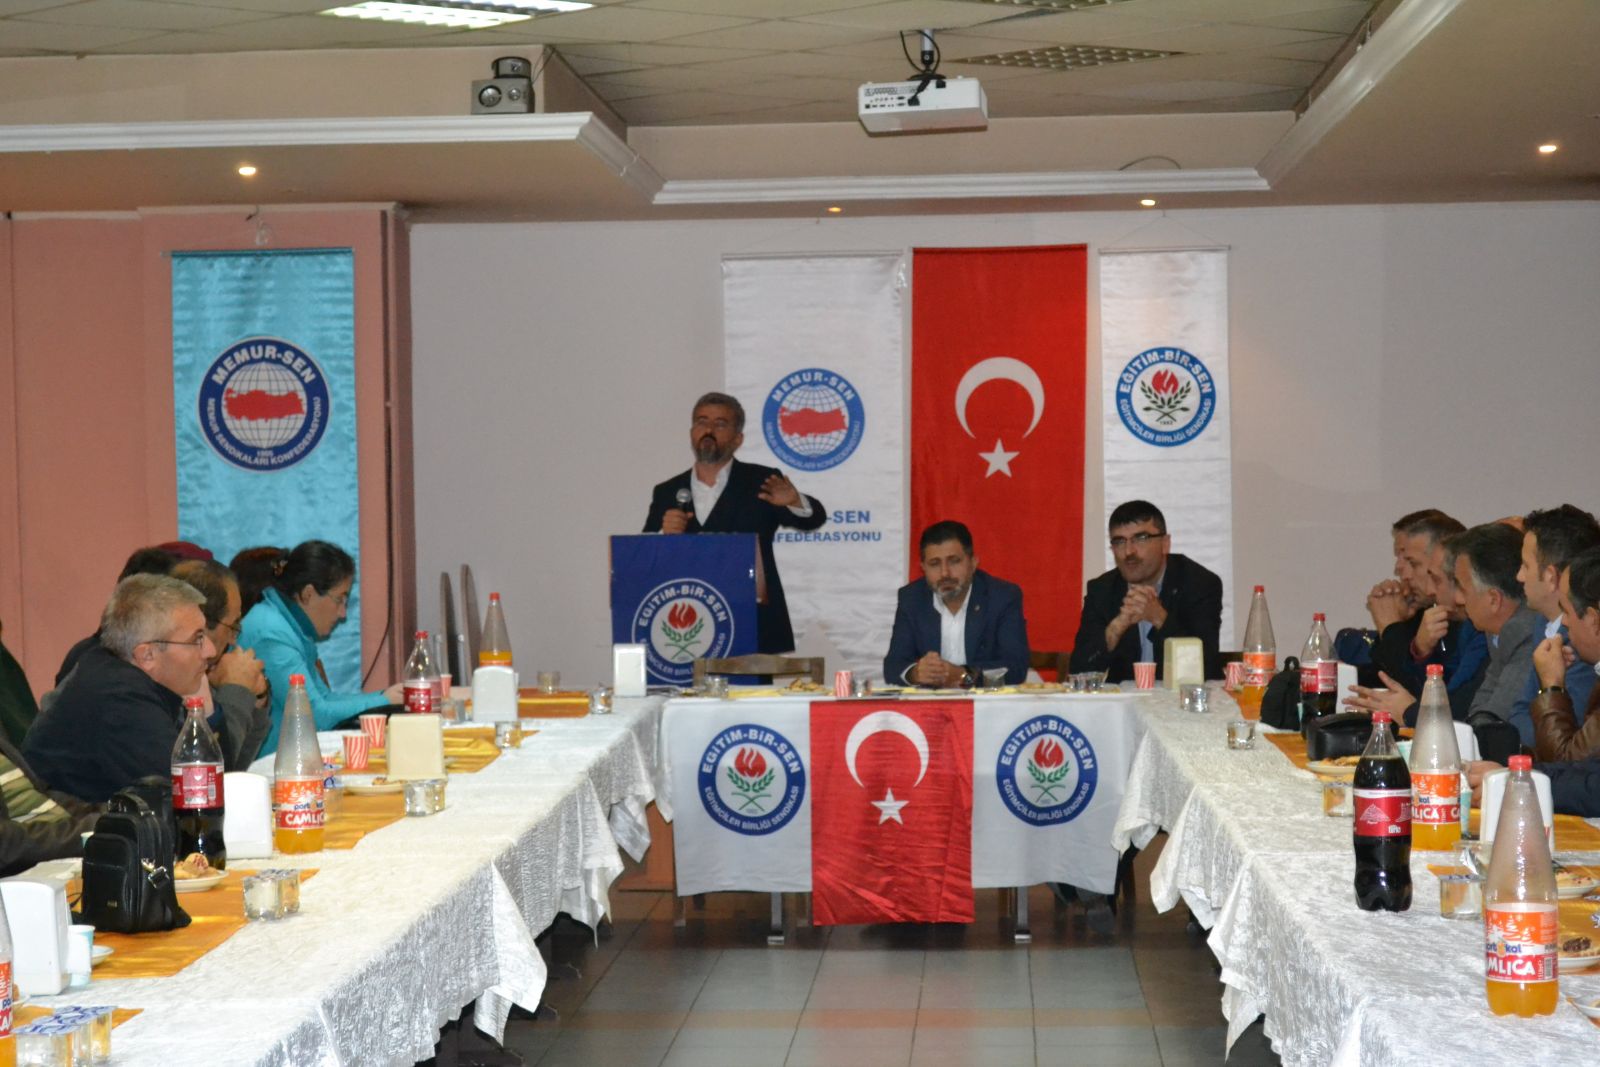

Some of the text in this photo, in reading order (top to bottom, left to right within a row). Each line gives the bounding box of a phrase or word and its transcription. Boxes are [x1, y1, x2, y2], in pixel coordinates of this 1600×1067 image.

[211, 344, 317, 386] MEMUR-SEN
[771, 371, 856, 402] MEMUR-SEN
[827, 510, 871, 524] -SEN
[773, 530, 882, 543] FEDERASYONU
